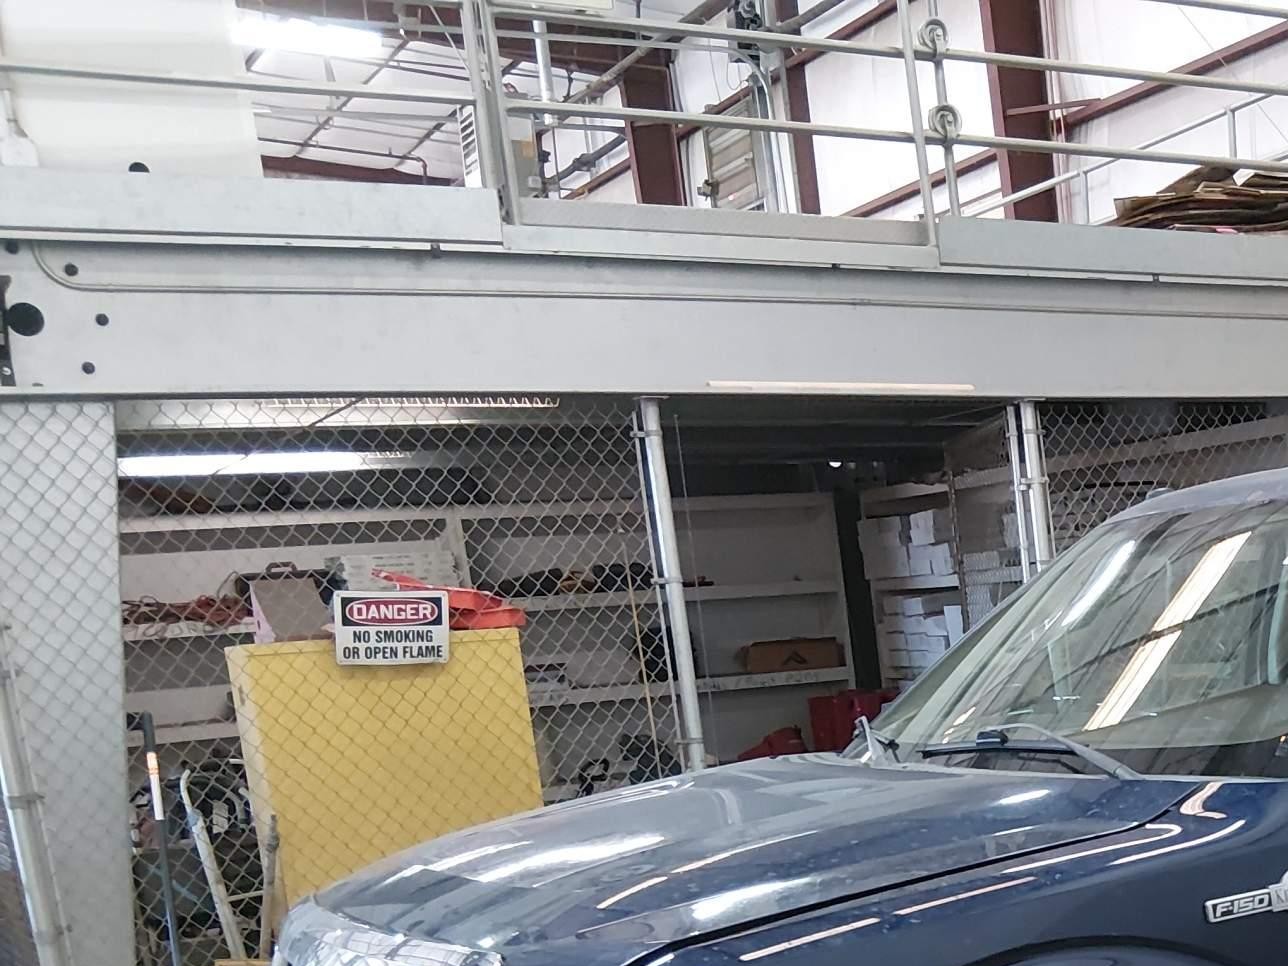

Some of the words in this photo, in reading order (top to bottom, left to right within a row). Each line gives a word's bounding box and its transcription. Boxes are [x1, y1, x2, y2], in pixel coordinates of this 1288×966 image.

[352, 603, 433, 620] DANGER
[352, 630, 371, 644] NO
[375, 629, 434, 643] SMOKING
[342, 646, 360, 660] OR
[364, 645, 399, 660] OPEN
[402, 645, 443, 659] FLAME
